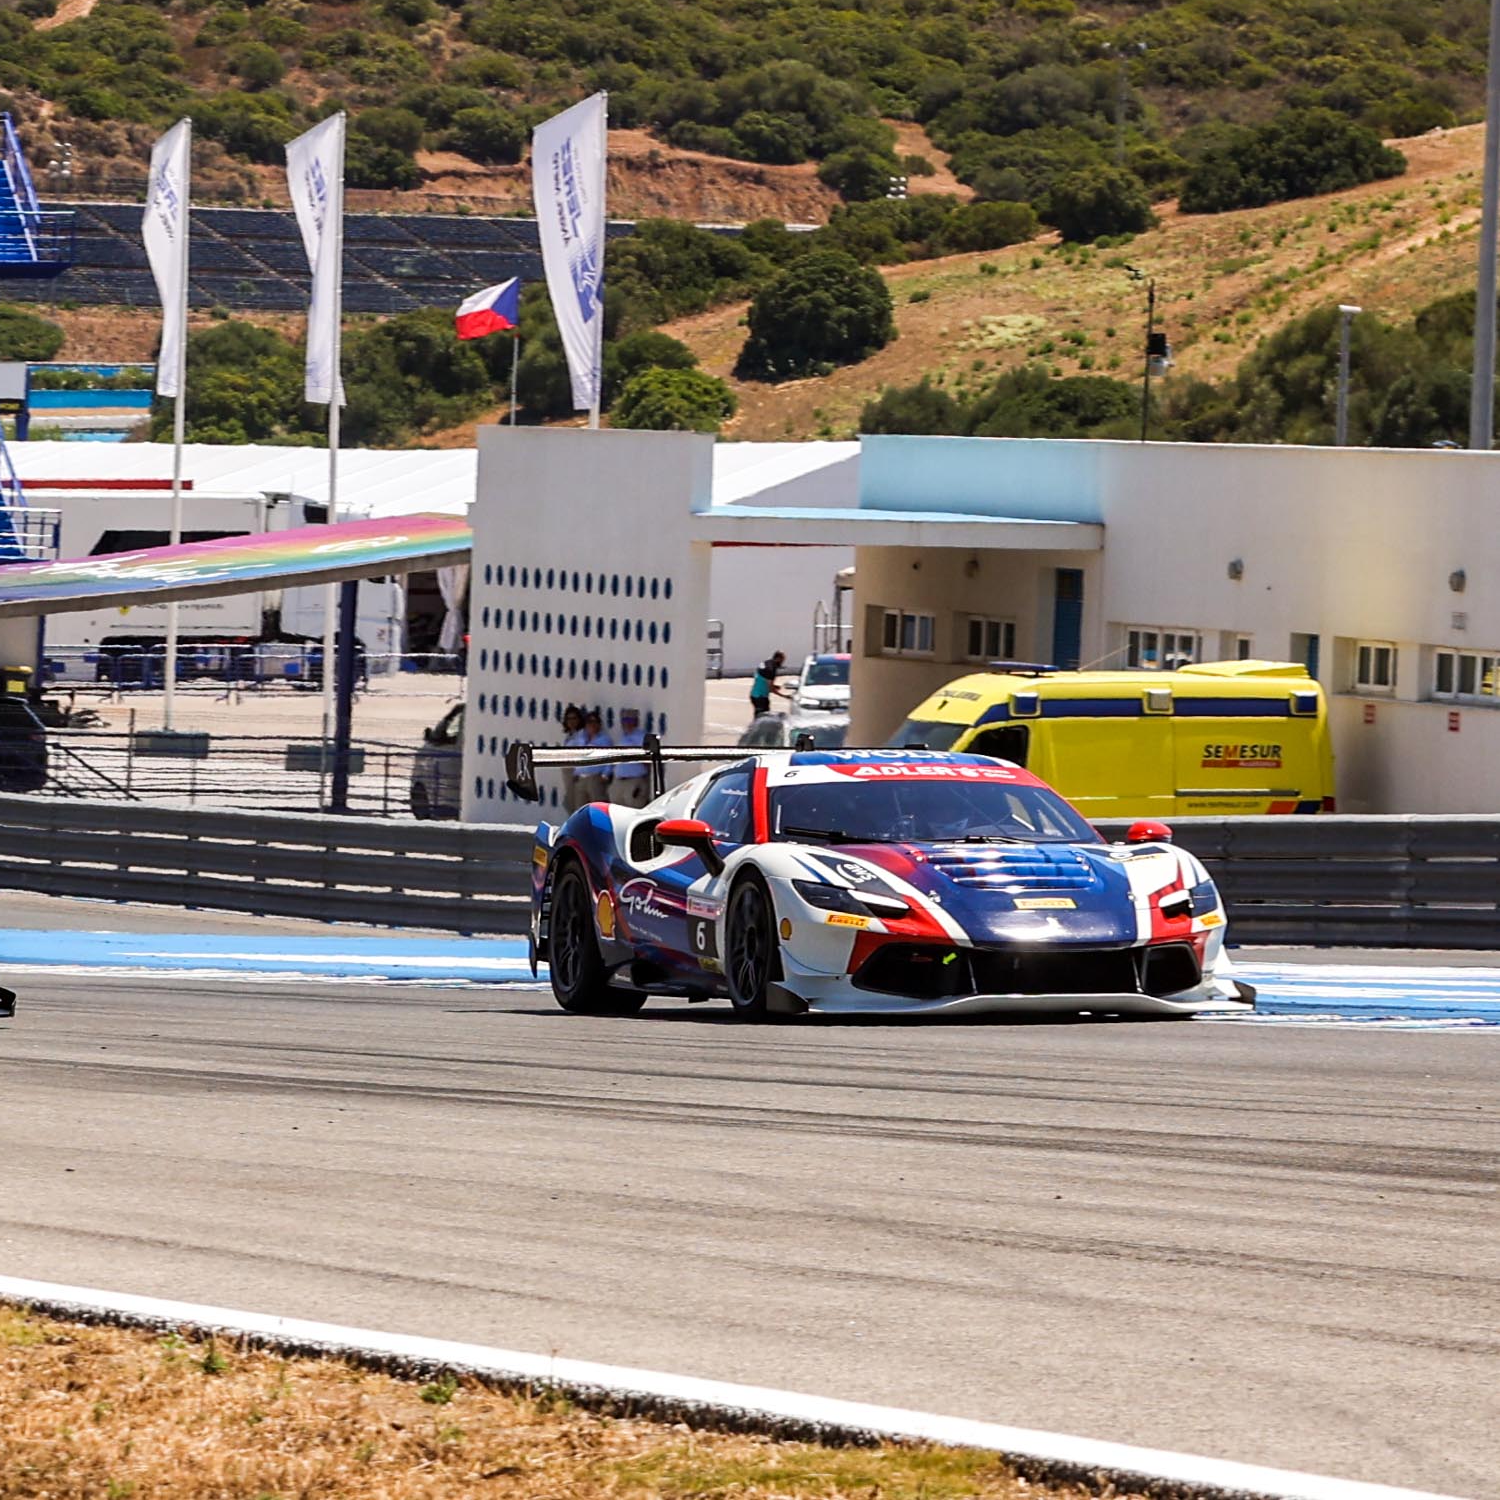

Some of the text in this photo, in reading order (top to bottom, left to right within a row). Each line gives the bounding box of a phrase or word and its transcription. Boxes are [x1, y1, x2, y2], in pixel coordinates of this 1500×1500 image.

[1203, 744, 1282, 758] SEMESUR
[853, 766, 956, 777] ADLER
[843, 863, 877, 881] aws
[828, 914, 867, 927] PIRELLI
[696, 921, 706, 951] 6
